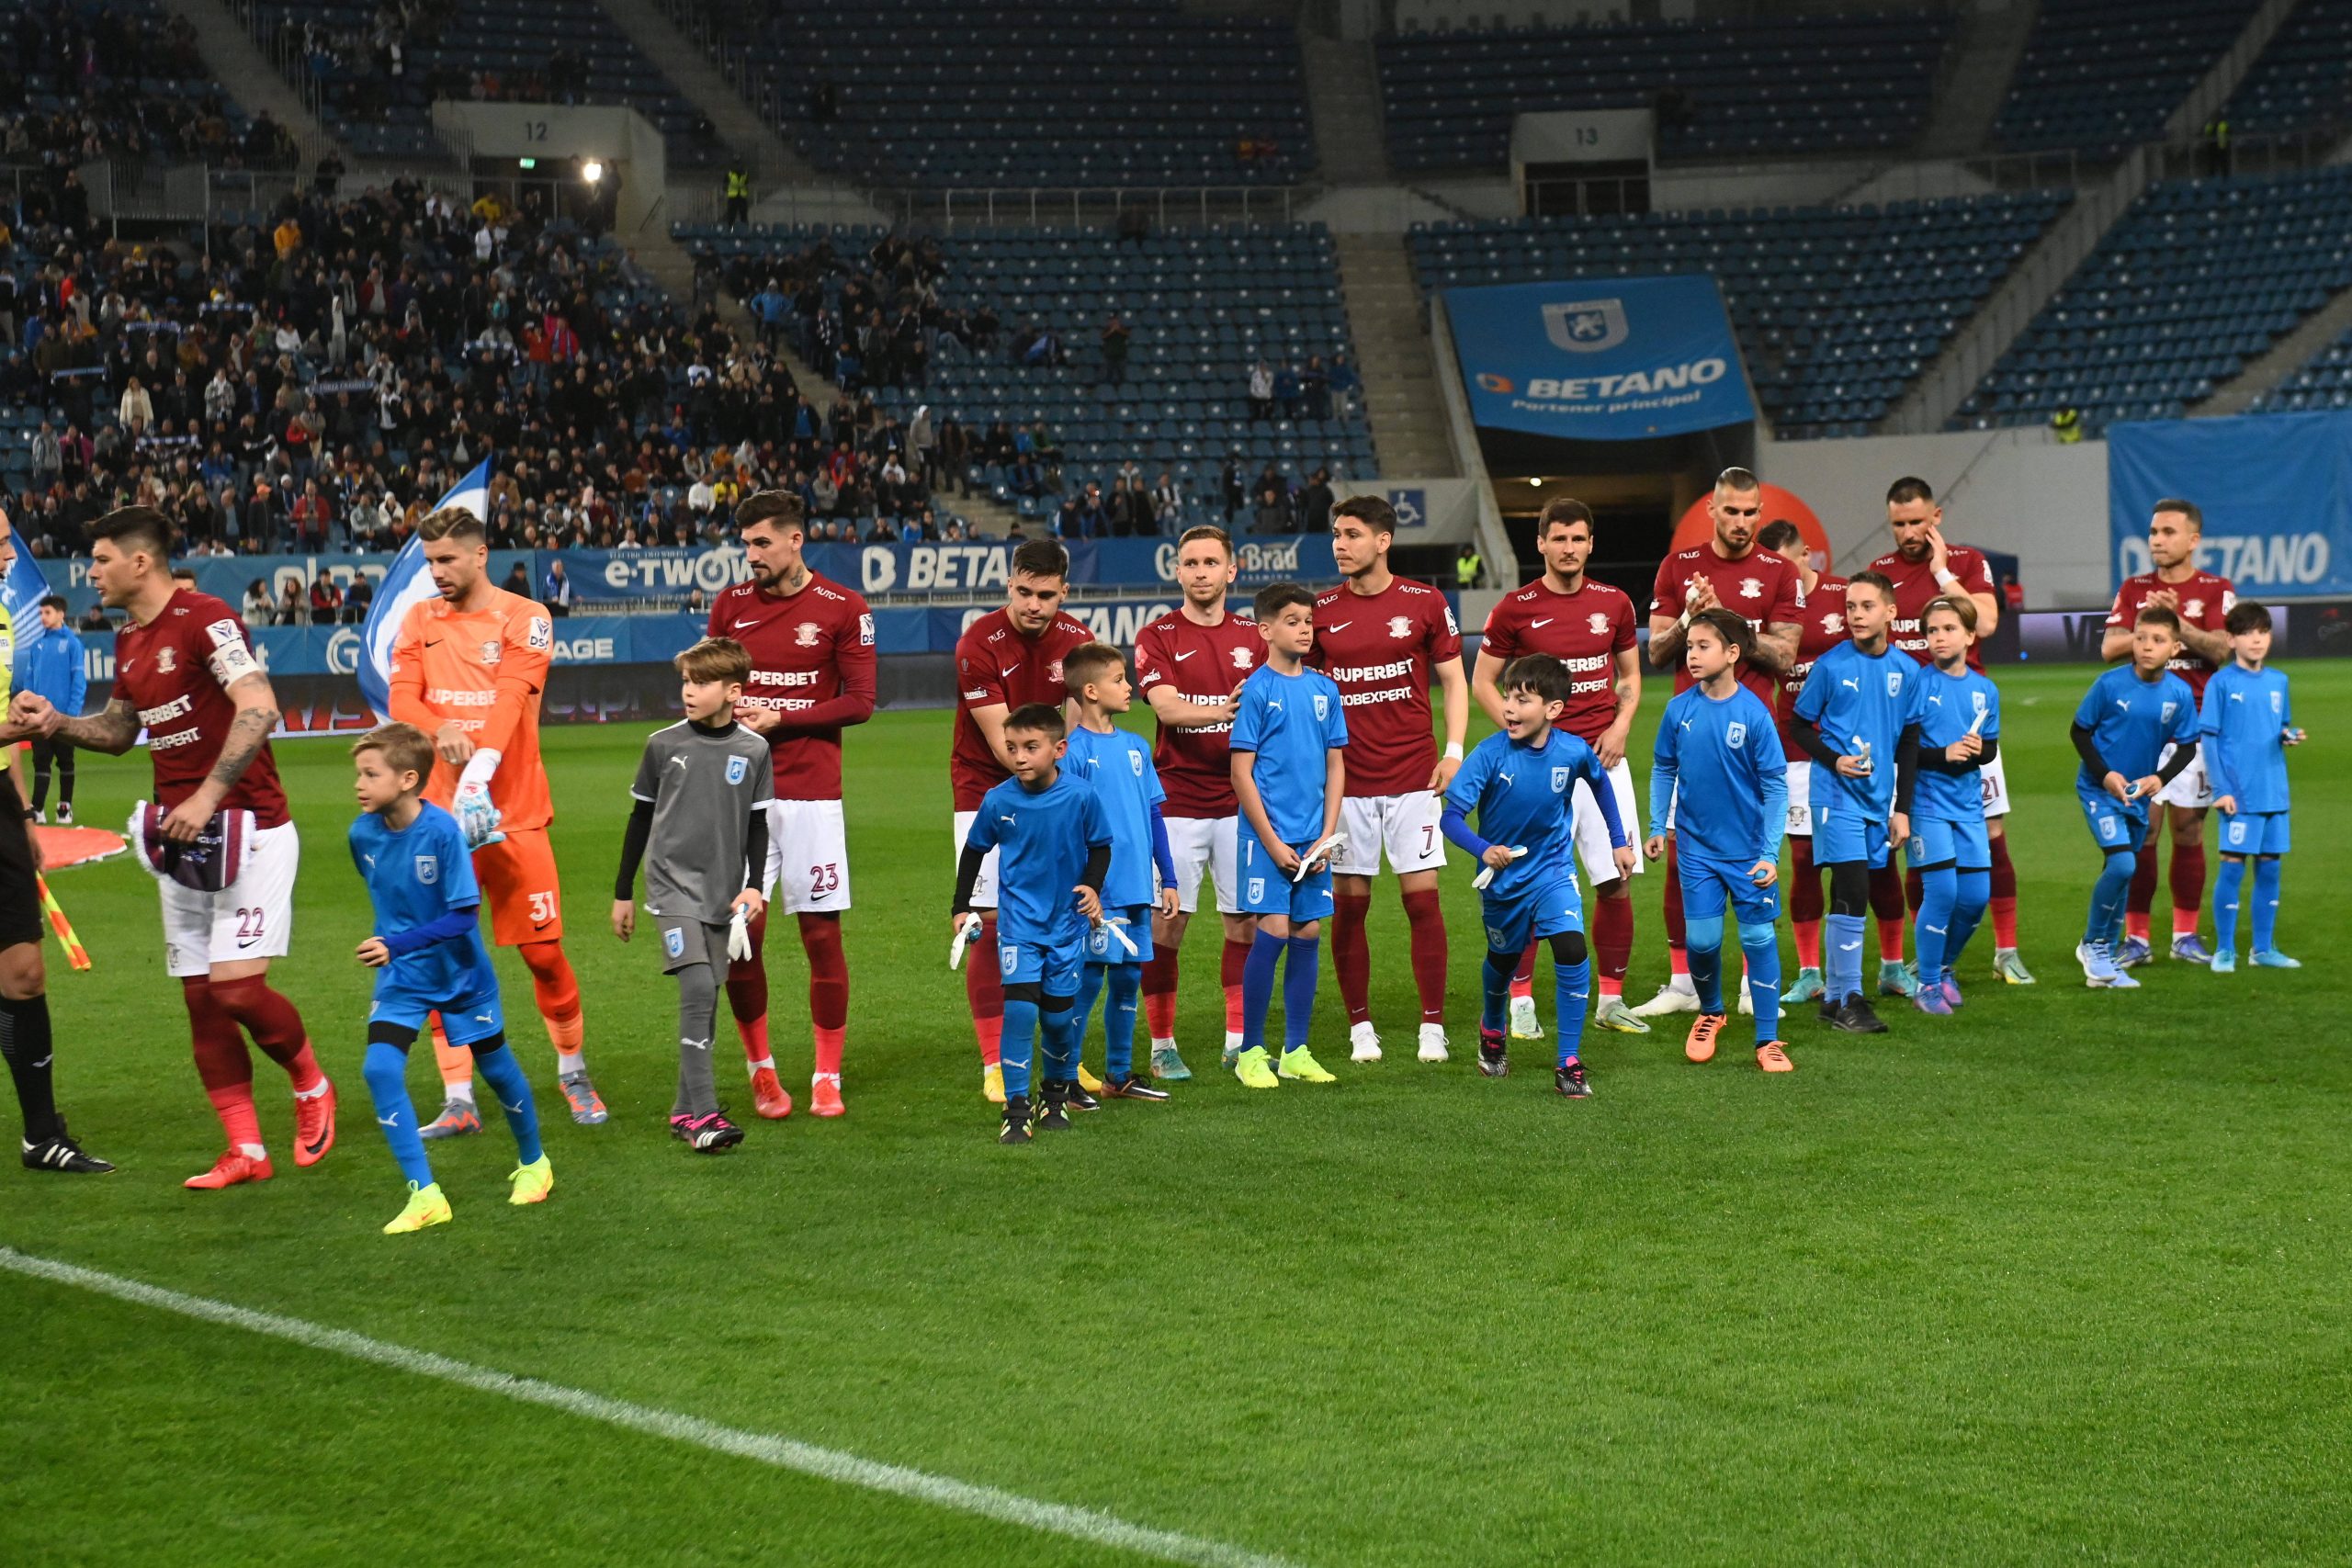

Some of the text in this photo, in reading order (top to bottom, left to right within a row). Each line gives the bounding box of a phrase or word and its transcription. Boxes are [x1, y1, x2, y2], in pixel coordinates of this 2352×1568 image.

[526, 121, 548, 141] 12
[1576, 128, 1598, 146] 13
[1527, 357, 1727, 400] BETANO
[1511, 389, 1702, 413] Partener principal
[1238, 539, 1299, 571] Brad
[2192, 532, 2330, 585] ETANO
[1317, 593, 1339, 608] PLUS
[1398, 584, 1421, 594] AUTO
[988, 628, 1006, 644] PLUS
[553, 637, 614, 660] AGE
[1333, 658, 1414, 682] SUPERBET
[2164, 659, 2204, 671] EXPERT
[749, 670, 820, 686] PERBET
[1571, 678, 1609, 694] EXPERT
[138, 694, 193, 727] PERBET
[1982, 776, 2000, 801] 21
[1421, 825, 1434, 851] 7
[809, 863, 839, 893] 23
[528, 890, 557, 921] 31
[236, 907, 265, 938] 22
